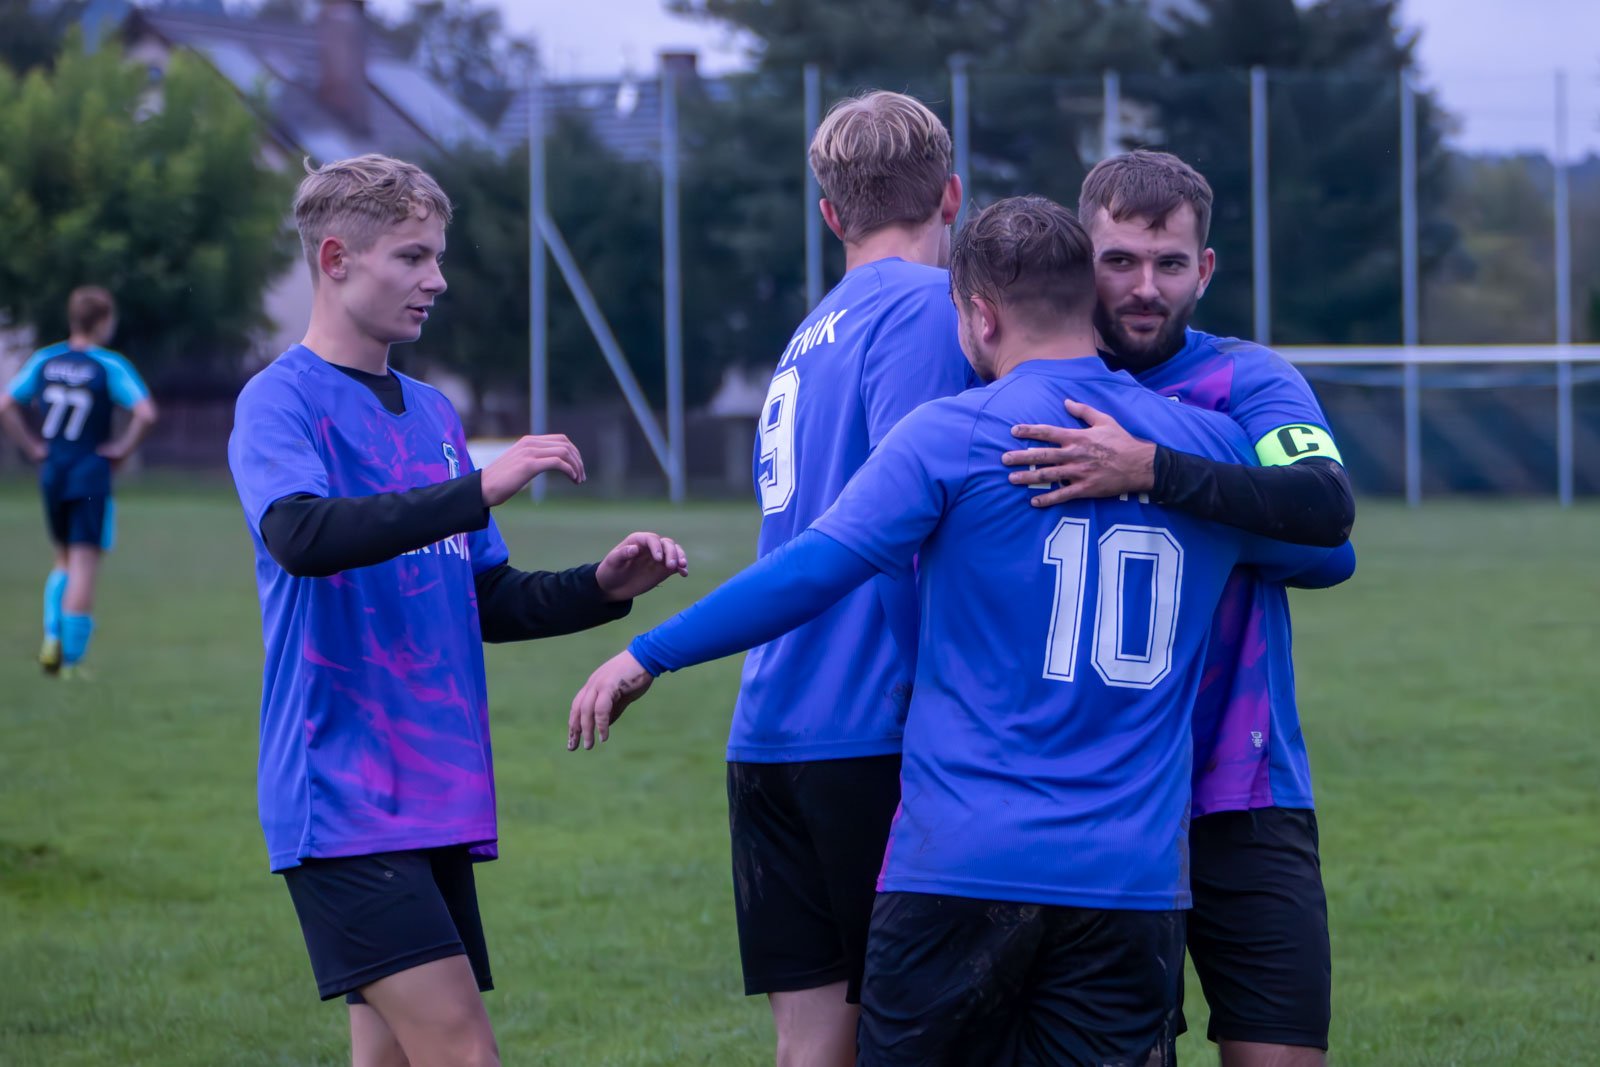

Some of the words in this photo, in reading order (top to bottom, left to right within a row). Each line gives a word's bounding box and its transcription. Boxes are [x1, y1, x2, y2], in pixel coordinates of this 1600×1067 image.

[781, 308, 848, 367] TNIK
[42, 385, 93, 441] 77
[758, 366, 801, 516] 9
[1276, 426, 1319, 457] C
[1042, 516, 1184, 690] 10
